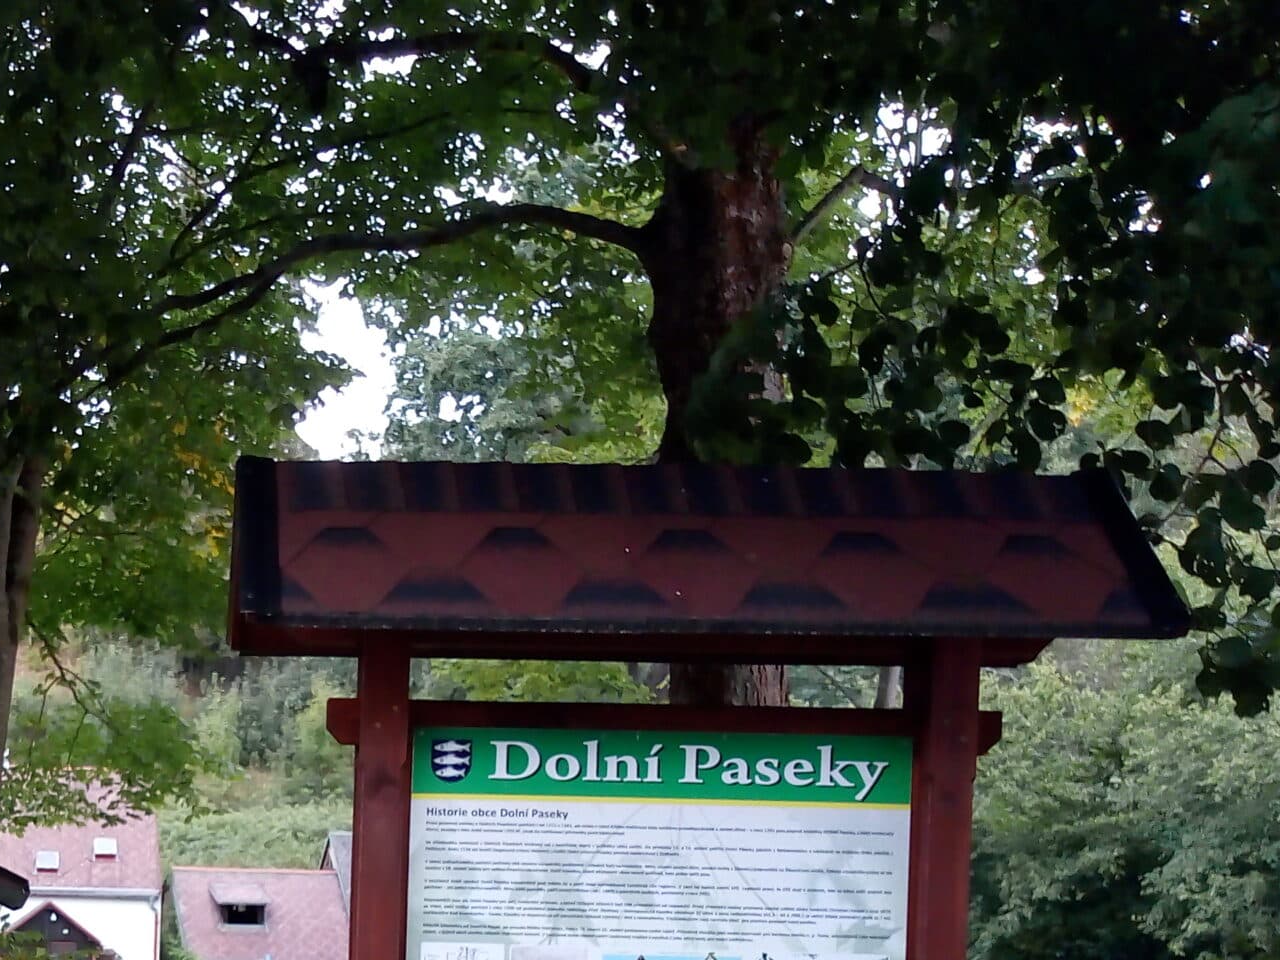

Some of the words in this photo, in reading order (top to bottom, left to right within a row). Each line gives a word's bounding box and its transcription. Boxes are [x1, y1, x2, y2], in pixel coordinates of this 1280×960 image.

[488, 739, 665, 785] Dolní
[678, 743, 889, 802] Paseky
[426, 807, 468, 817] Historie
[471, 808, 497, 818] obce
[500, 807, 528, 819] Dolní
[531, 809, 569, 821] Paseky
